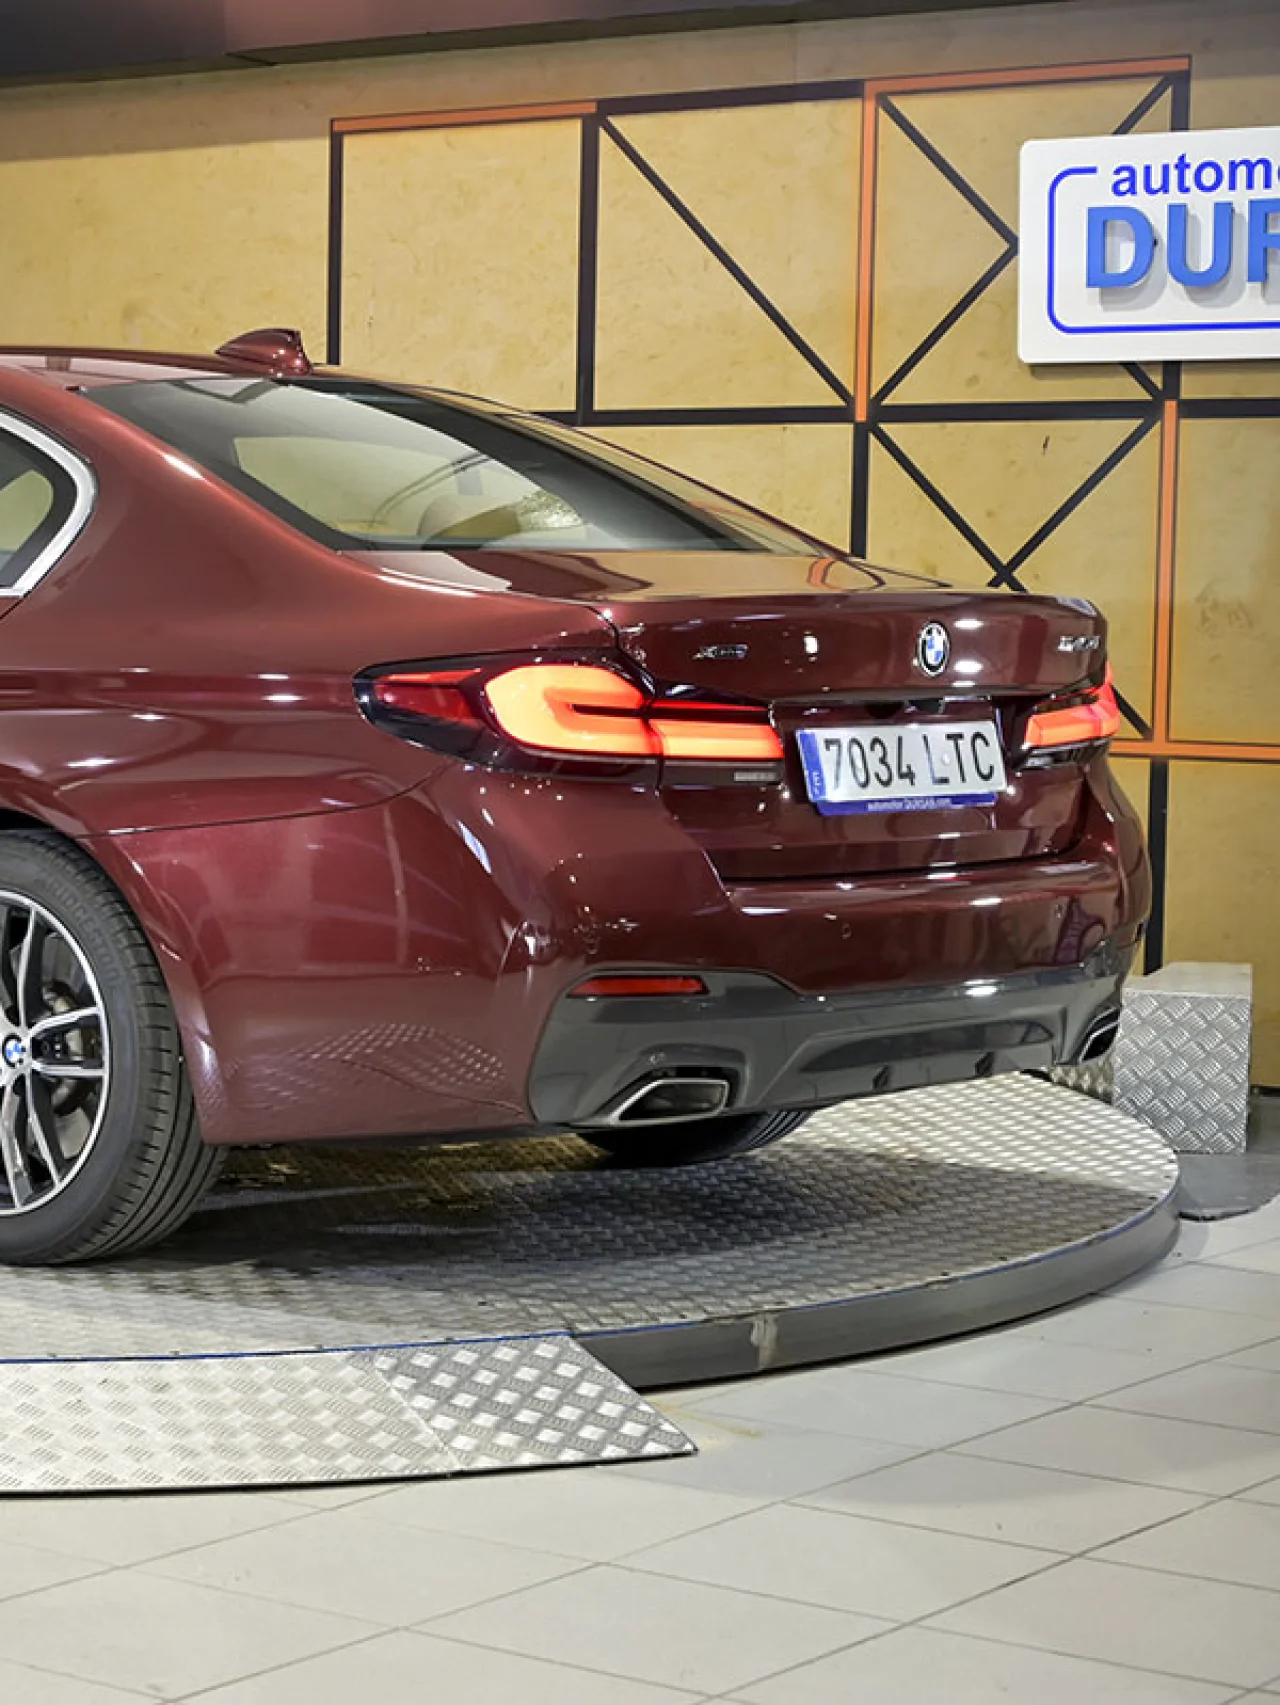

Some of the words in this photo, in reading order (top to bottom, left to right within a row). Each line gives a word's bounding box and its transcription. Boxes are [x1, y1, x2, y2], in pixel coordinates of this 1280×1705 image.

[1111, 153, 1280, 197] autom
[823, 735, 916, 790] 7034
[923, 731, 995, 783] LTC
[33, 873, 123, 987] RIDGESTON
